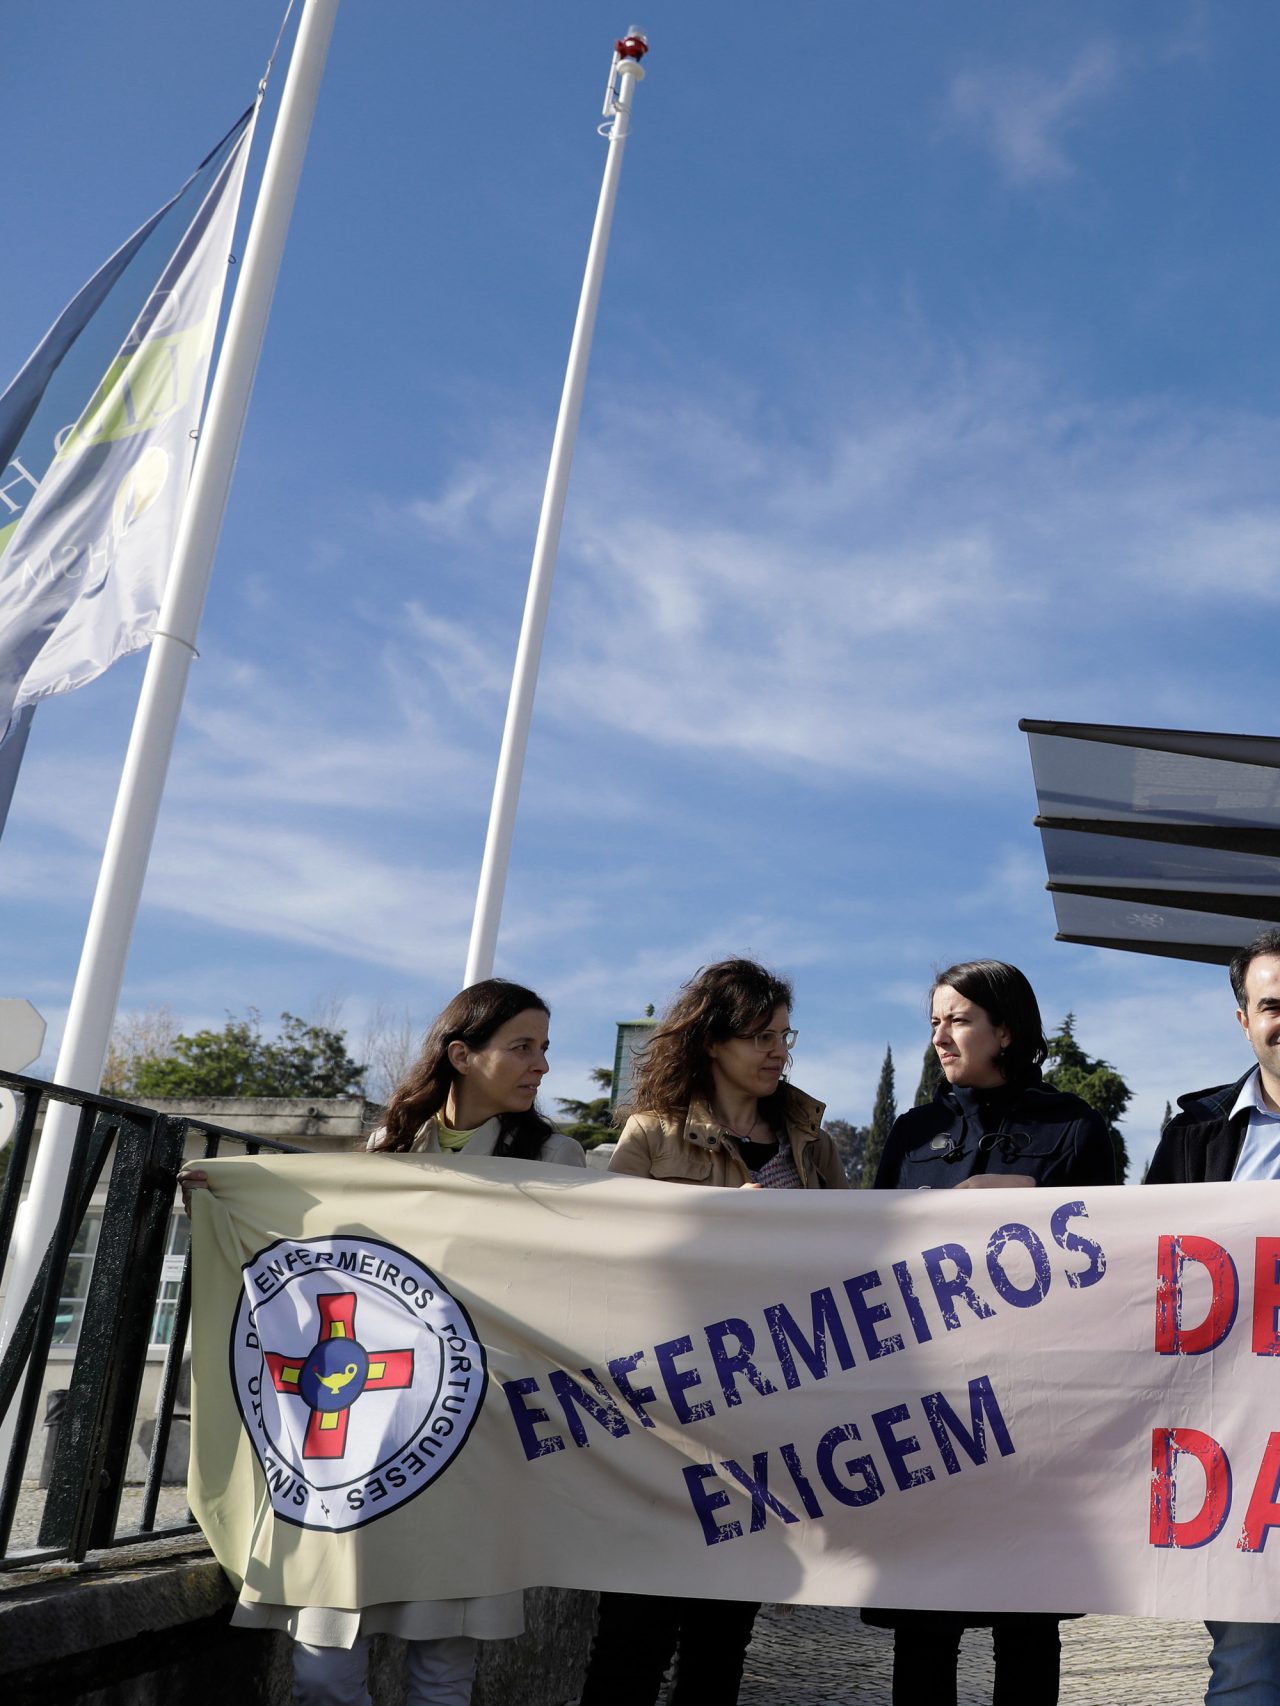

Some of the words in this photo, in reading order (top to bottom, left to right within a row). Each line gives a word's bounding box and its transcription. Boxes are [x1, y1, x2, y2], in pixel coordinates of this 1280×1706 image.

[253, 1249, 434, 1310] ENFERMEIROS
[502, 1199, 1107, 1461] ENFERMEIROS
[681, 1374, 1017, 1547] EXIGEM
